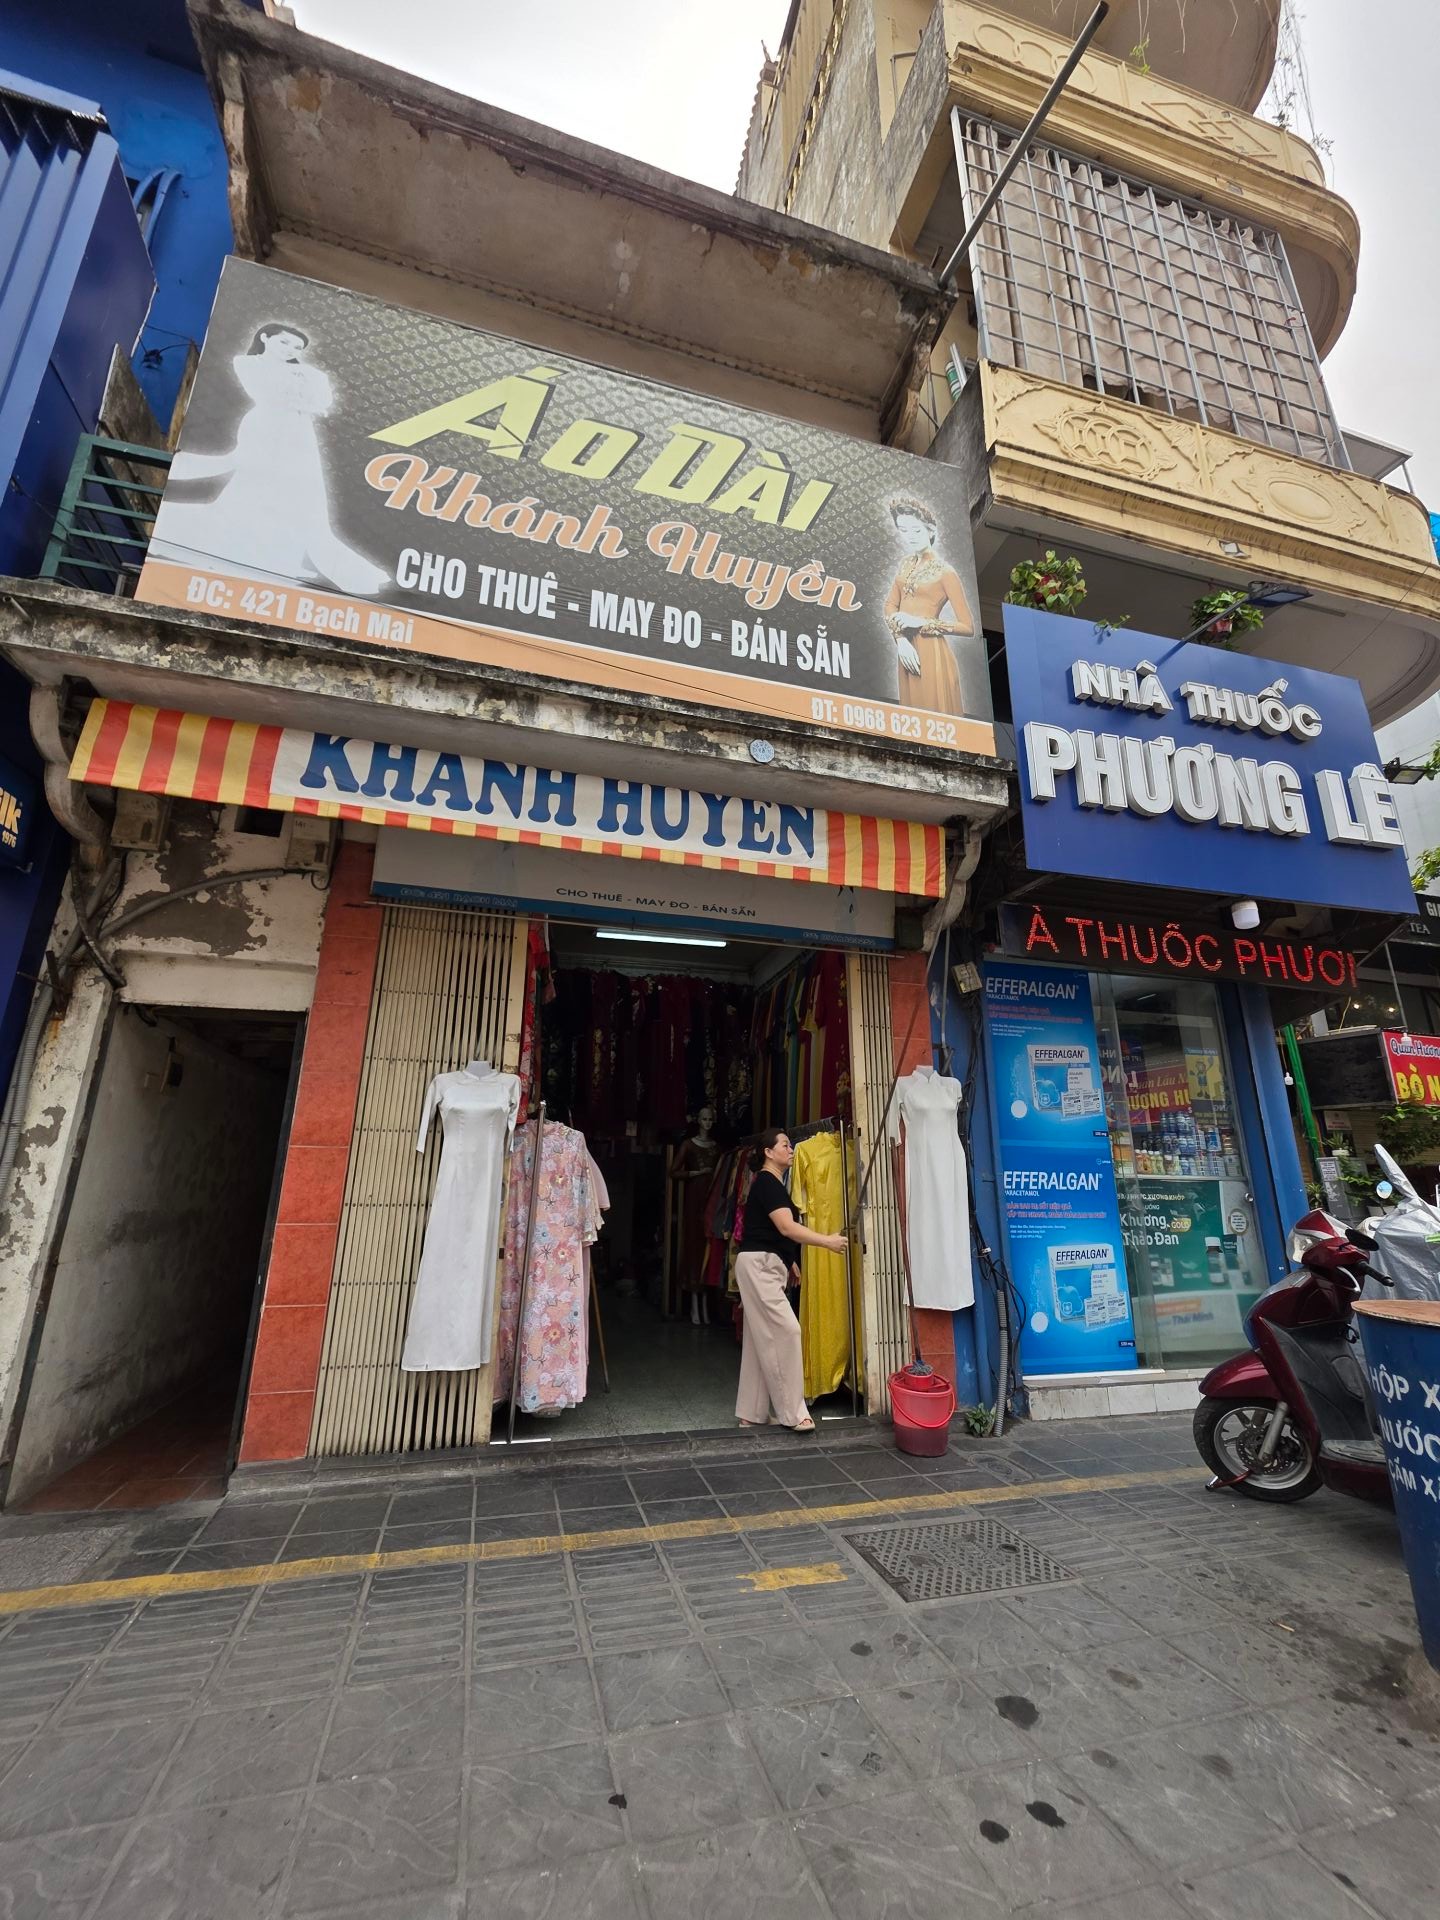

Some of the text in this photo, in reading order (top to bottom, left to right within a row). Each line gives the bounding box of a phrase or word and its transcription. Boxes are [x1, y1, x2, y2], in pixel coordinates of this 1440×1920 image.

[365, 452, 862, 612] Khánh Huyền
[186, 576, 414, 644] ĐC: 421 Bạch Mai
[397, 548, 466, 598] CHO
[478, 565, 558, 619] THUÊ
[589, 589, 658, 638] MAY
[662, 606, 702, 649] ĐO
[731, 617, 788, 667] BÁN
[797, 624, 851, 679] SẴN
[1071, 659, 1323, 742] NHÀ THUỐC
[811, 697, 958, 745] ĐT: 0968 623 252
[1023, 721, 1405, 850] PHƯƠNG LÊ
[556, 887, 588, 898] CHO
[592, 892, 623, 902] THUÊ
[636, 897, 666, 907] MAY
[670, 900, 690, 909] ĐO
[702, 902, 728, 914] BÁN
[1410, 922, 1431, 935] TEA
[985, 976, 1076, 1000] EFFERALGAN
[1034, 1049, 1083, 1059] EFFERALGAN
[1395, 1063, 1425, 1101] BÒ
[1003, 1170, 1099, 1191] EFFERALGAN
[1120, 1212, 1167, 1230] Khương
[1056, 1248, 1108, 1261] EFFERALGAN
[1154, 1231, 1179, 1246] Đan
[1369, 1363, 1410, 1404] HỘP
